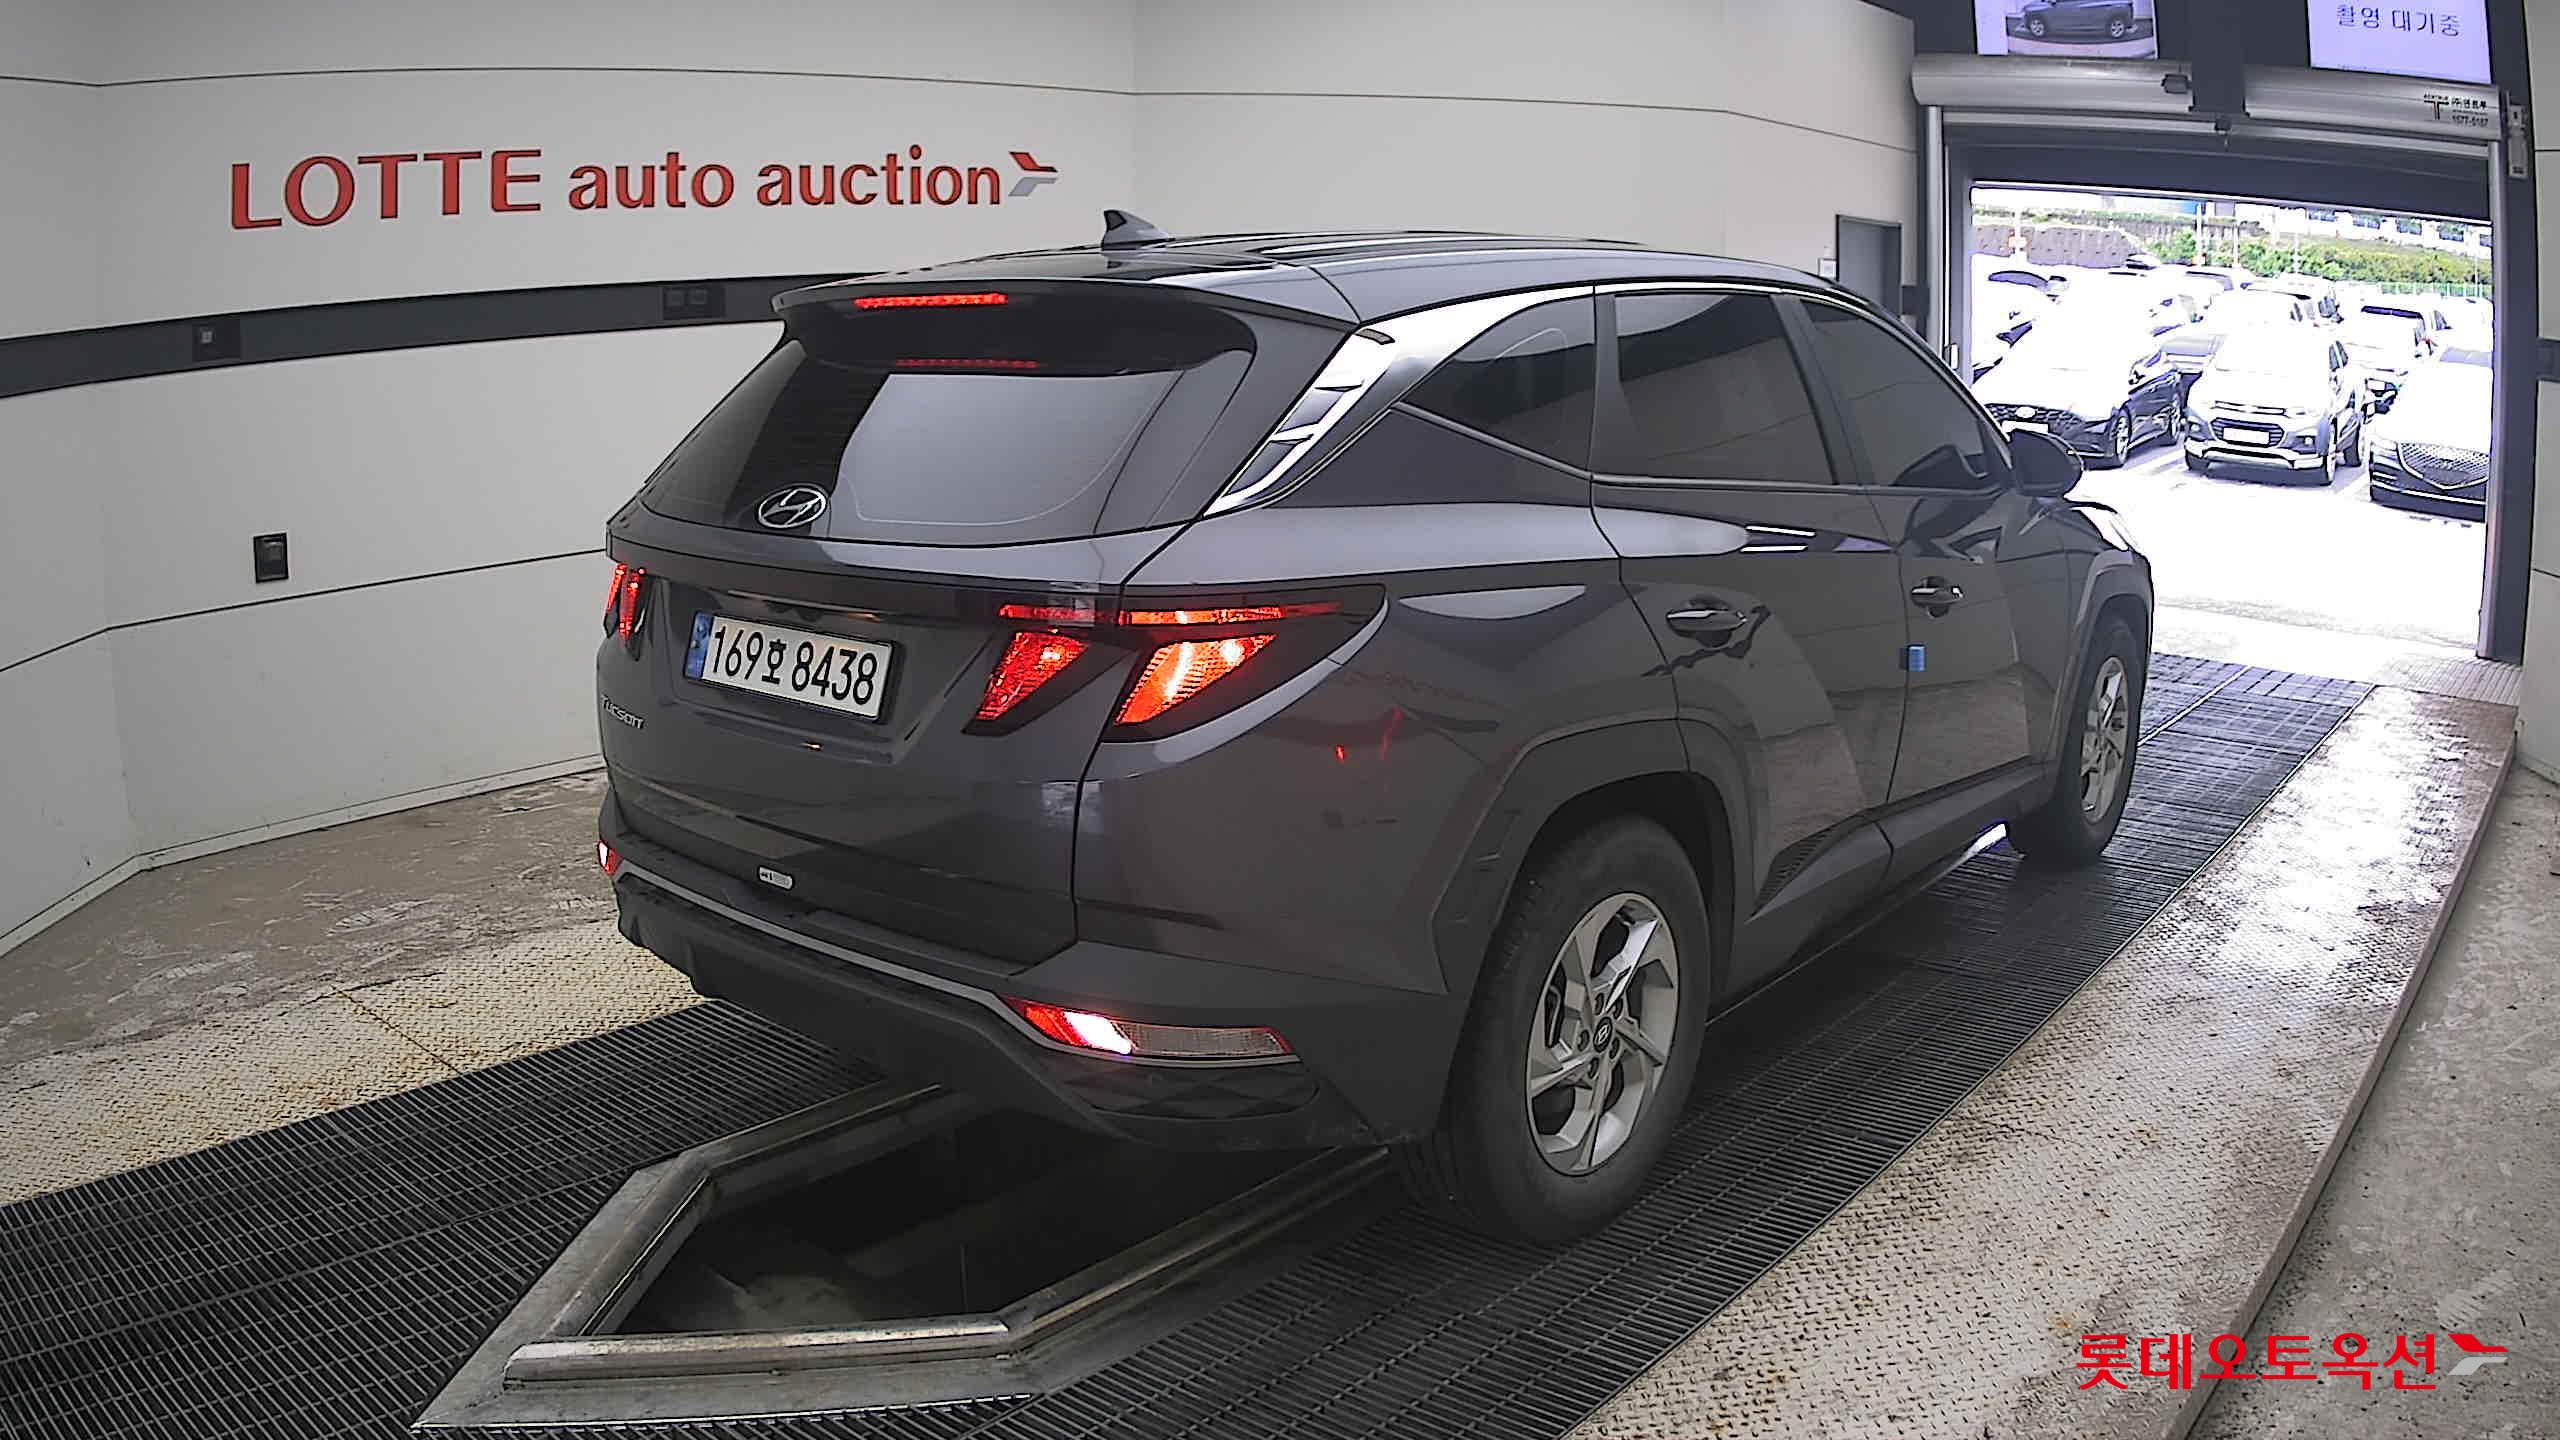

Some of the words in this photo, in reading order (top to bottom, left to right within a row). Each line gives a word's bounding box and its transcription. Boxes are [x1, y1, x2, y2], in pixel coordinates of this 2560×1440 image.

[2336, 4, 2380, 30] 촬영
[2391, 9, 2460, 37] 대기중
[231, 149, 542, 230] LOTTE
[568, 151, 735, 210] auto
[756, 143, 1001, 206] auction
[712, 624, 788, 685] 169호
[790, 639, 878, 706] 8438
